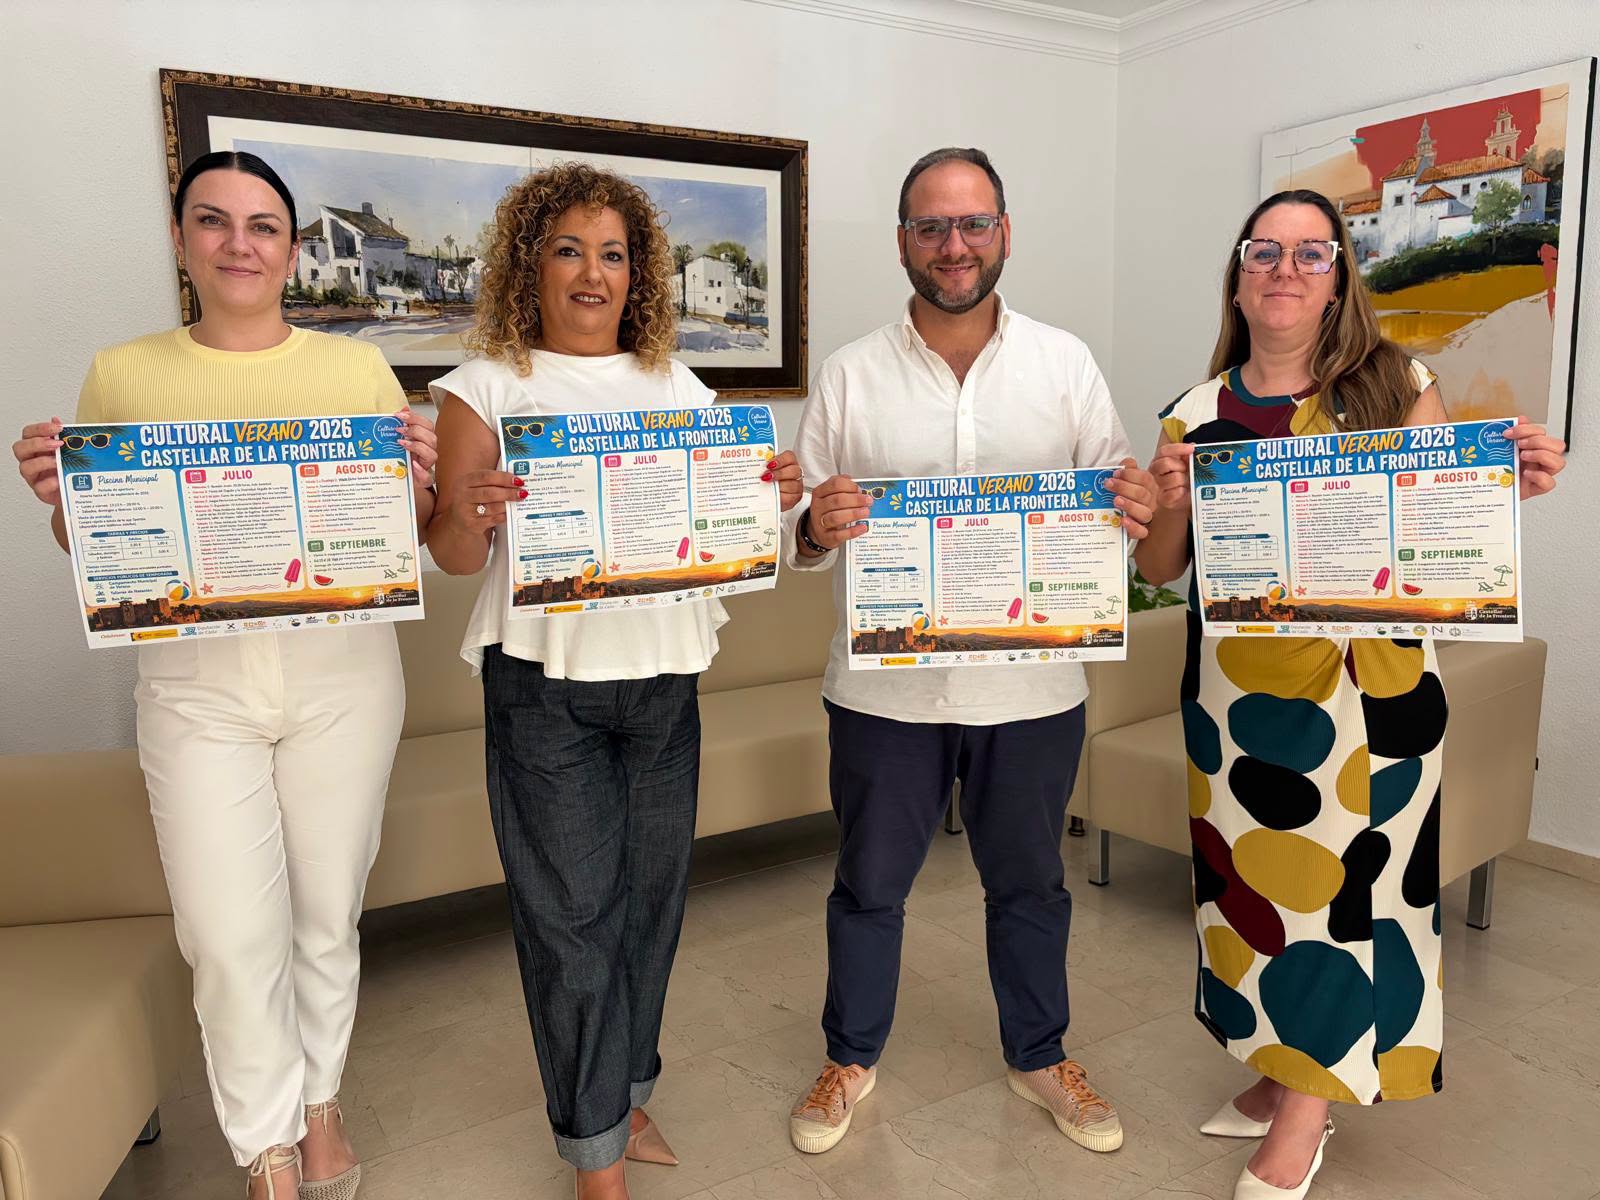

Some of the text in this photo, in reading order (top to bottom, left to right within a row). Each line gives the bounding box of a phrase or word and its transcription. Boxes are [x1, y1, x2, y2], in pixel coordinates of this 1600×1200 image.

[566, 408, 733, 435] CULTURAL VERANO 2026
[139, 419, 353, 447] CULTURAL VERANO 2026
[569, 428, 737, 454] CASTELLAR DE LA FRONTERA
[1257, 426, 1455, 461] CULTURAL VERANO 2026
[141, 441, 357, 467] CASTELLAR DE LA FRONTERA
[720, 449, 751, 459] AGOSTO
[534, 460, 583, 470] Piscina Municipal
[633, 455, 658, 465] JULIO
[1256, 449, 1458, 480] CASTELLAR DE LA FRONTERA
[222, 470, 252, 480] JULIO
[335, 464, 376, 475] AGOSTO
[97, 474, 158, 485] Piscina Municipal
[1434, 472, 1478, 484] AGOSTO
[907, 478, 975, 498] CULTURAL
[978, 475, 1034, 496] VERANO
[1039, 472, 1076, 492] 2026
[1220, 485, 1269, 495] Piscina Municipal
[1322, 480, 1350, 490] JULIO
[906, 493, 1078, 516] CASTELLAR DE LA FRONTERA
[712, 516, 757, 528] SEPTIEMBRE
[965, 518, 989, 526] JULIO
[1058, 513, 1094, 522] AGOSTO
[893, 521, 916, 529] Municipal
[330, 538, 386, 550] SEPTIEMBRE
[1421, 549, 1484, 559] SEPTIEMBRE
[1048, 582, 1099, 591] SEPTIEMBRE
